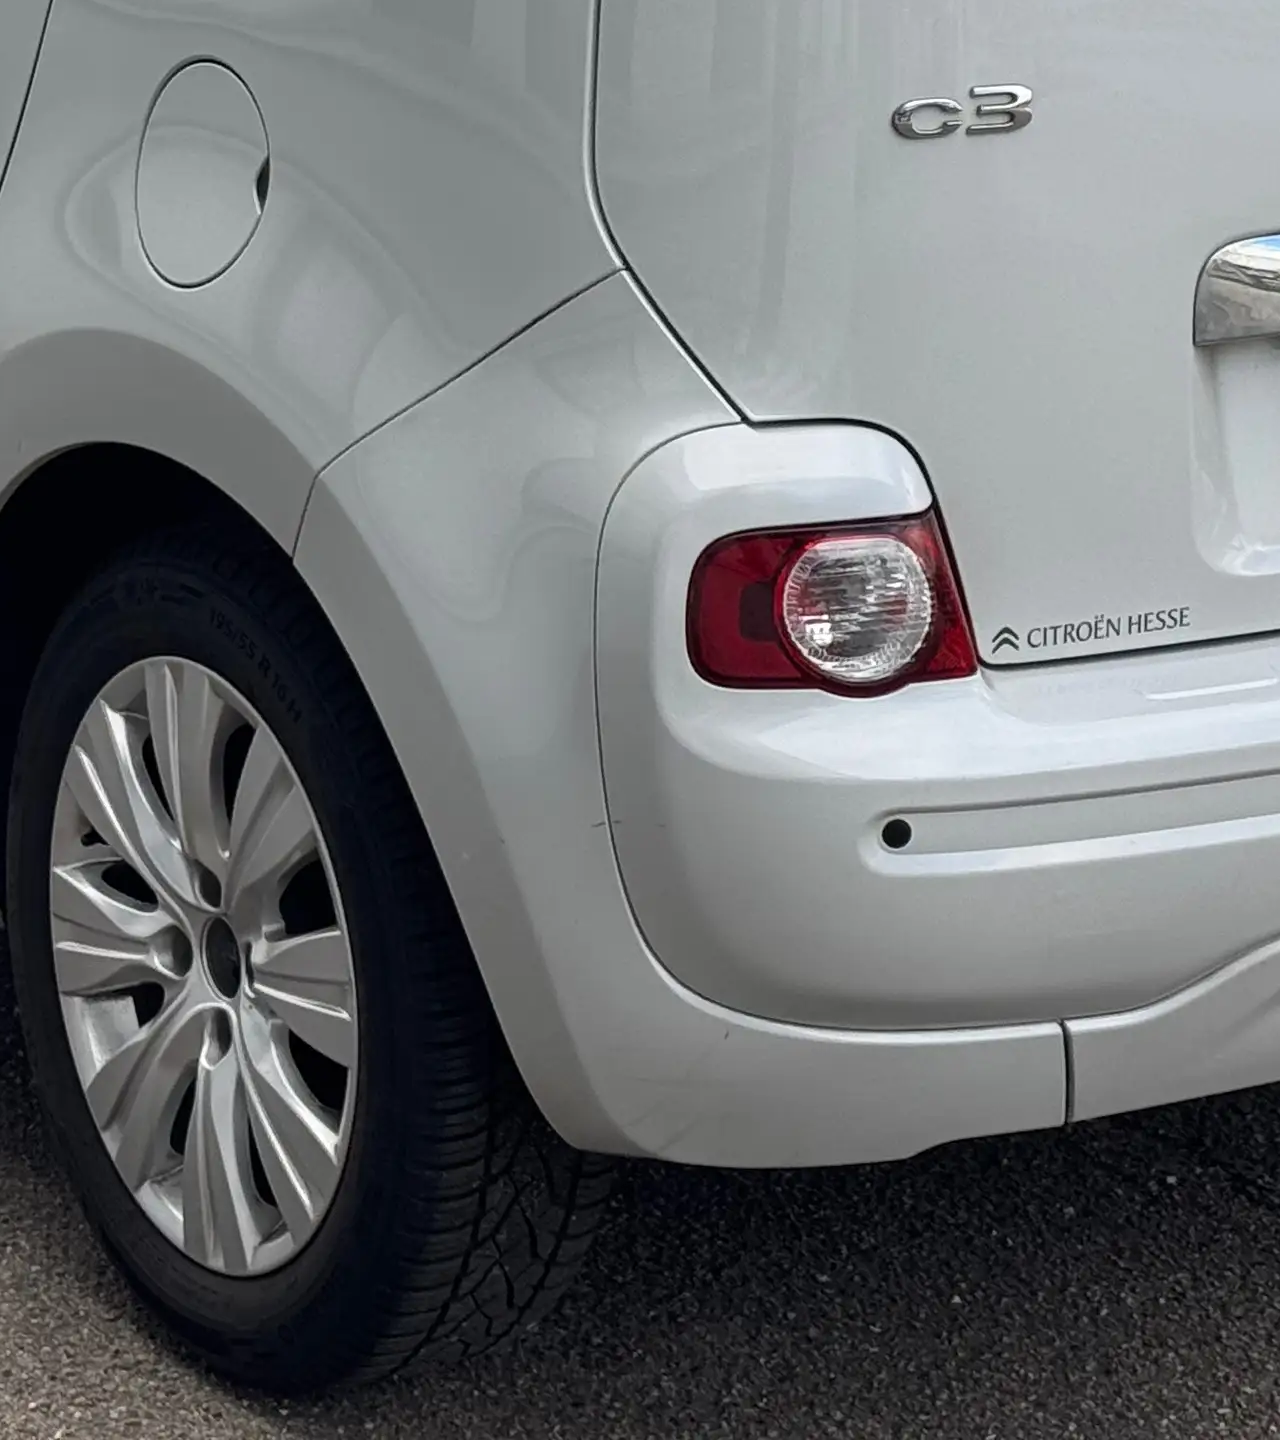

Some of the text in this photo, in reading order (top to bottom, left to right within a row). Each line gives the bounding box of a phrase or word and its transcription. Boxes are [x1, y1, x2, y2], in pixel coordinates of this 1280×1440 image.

[892, 83, 1033, 140] C3
[1026, 606, 1191, 649] CITROËN HESSE
